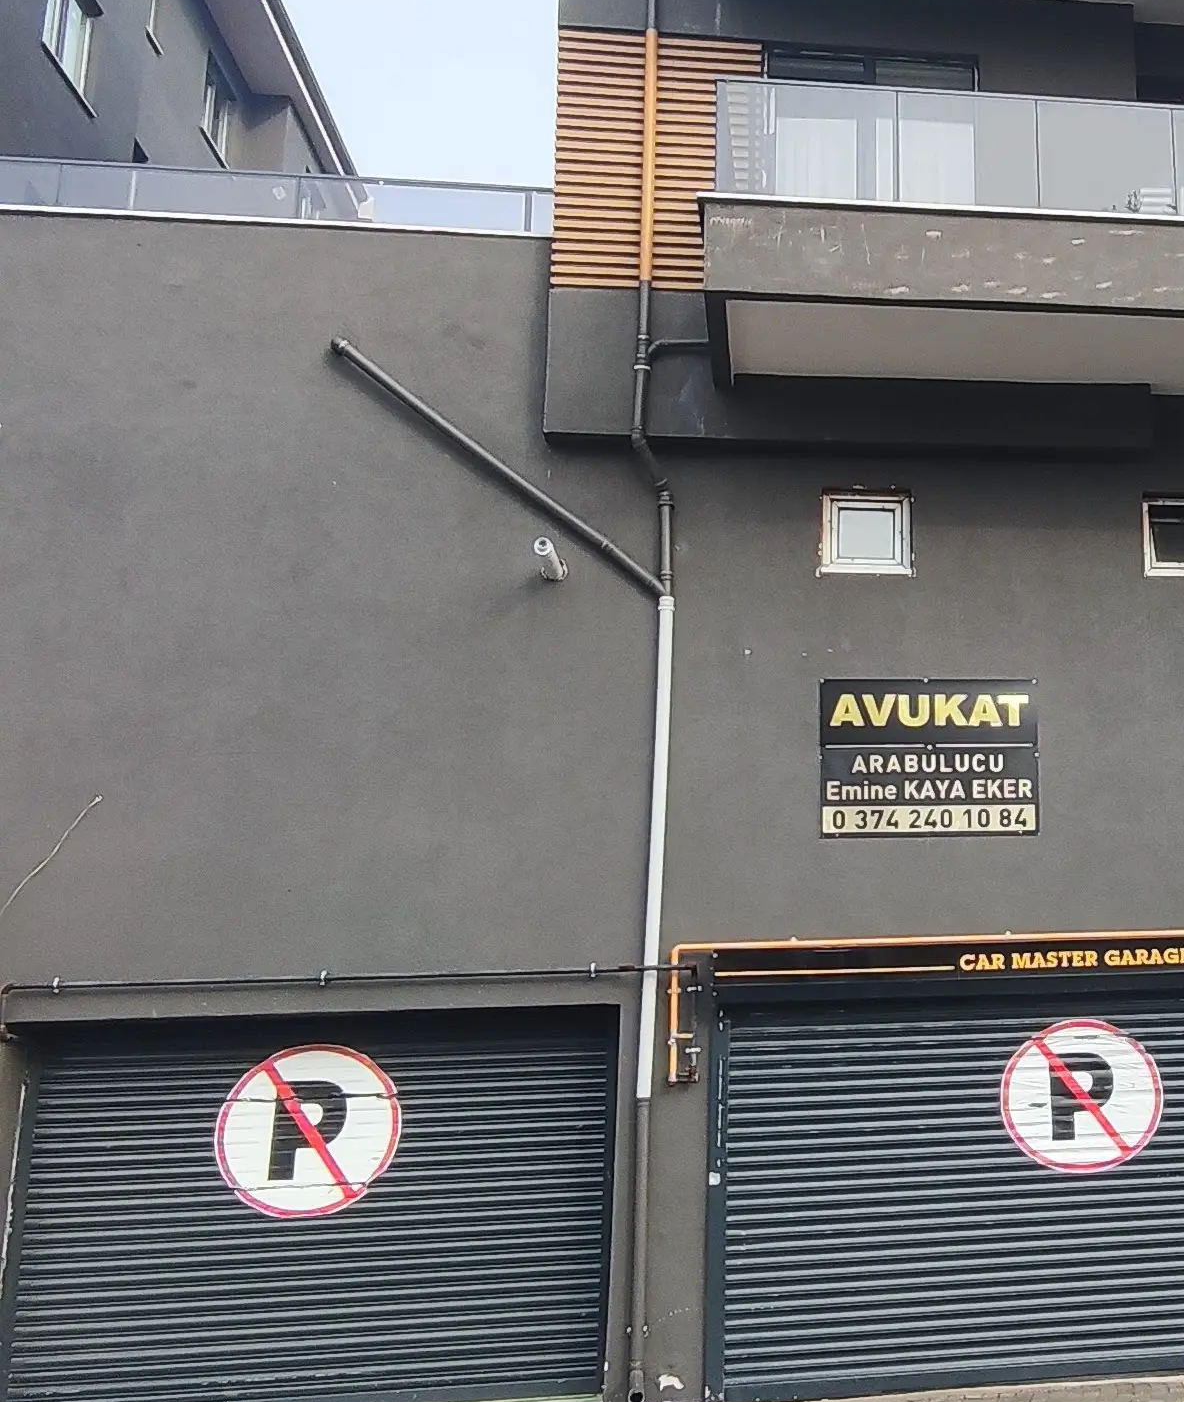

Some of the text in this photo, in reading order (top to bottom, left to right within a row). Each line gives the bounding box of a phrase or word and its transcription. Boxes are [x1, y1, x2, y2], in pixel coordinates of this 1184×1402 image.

[829, 693, 1029, 727] AVUKAT
[851, 753, 1004, 773] ARABULUCU
[826, 779, 1033, 801] Emine KAYA EKER
[832, 808, 1027, 829] 0 374 240 10 84
[959, 952, 1006, 971] CAR
[1010, 949, 1098, 970] MASTER
